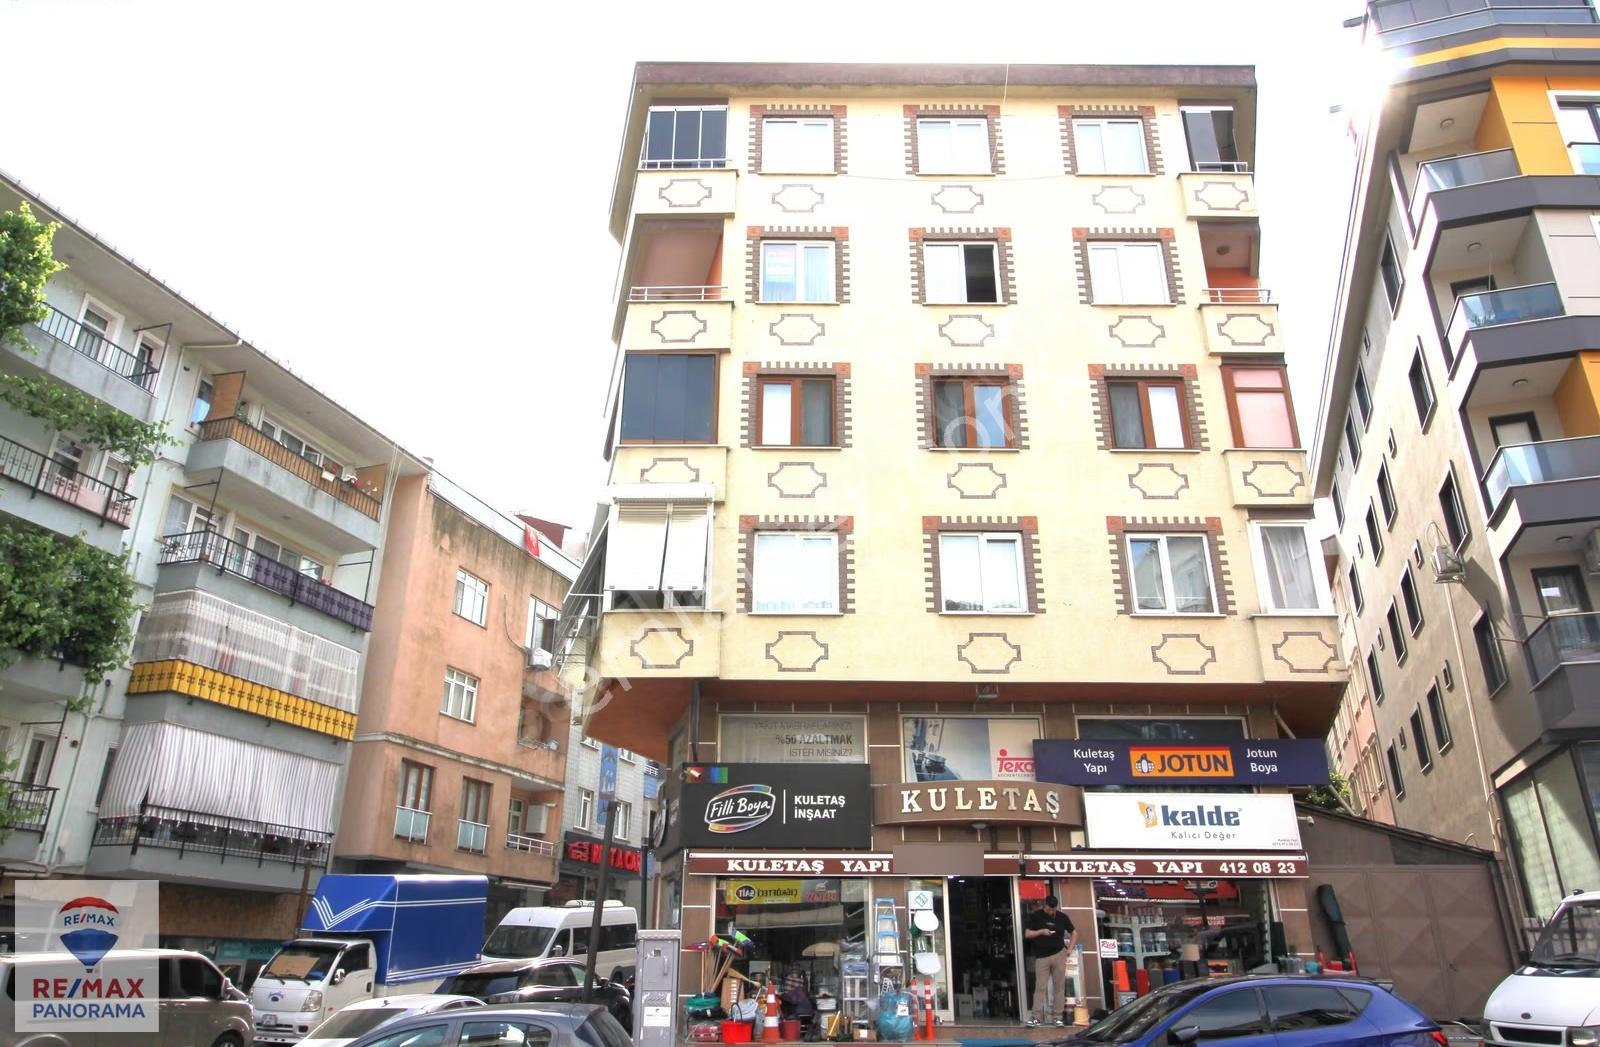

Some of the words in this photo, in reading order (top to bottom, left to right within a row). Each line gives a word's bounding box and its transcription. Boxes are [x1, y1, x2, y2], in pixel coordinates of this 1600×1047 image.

[799, 734, 852, 744] AZALTMAK
[1073, 748, 1115, 761] Kuletaş
[1246, 748, 1278, 759] Jotun
[1084, 763, 1108, 774] Yapı
[1157, 754, 1230, 774] JOTUN
[1250, 762, 1278, 774] Boya
[710, 802, 734, 818] Filli
[736, 796, 772, 815] Boya
[794, 794, 846, 808] KULETAŞ
[900, 784, 1061, 820] KULETAŞ
[794, 808, 837, 821] İNŞAAT
[1162, 805, 1240, 828] kalde
[1204, 831, 1237, 842] Değer
[726, 859, 825, 875] KULETAŞ
[840, 860, 891, 873] YAPI
[1037, 860, 1137, 876] KULETAŞ
[1151, 862, 1204, 875] YAPI
[1219, 863, 1248, 875] 412
[1253, 863, 1272, 875] 08
[1278, 863, 1297, 875] 23
